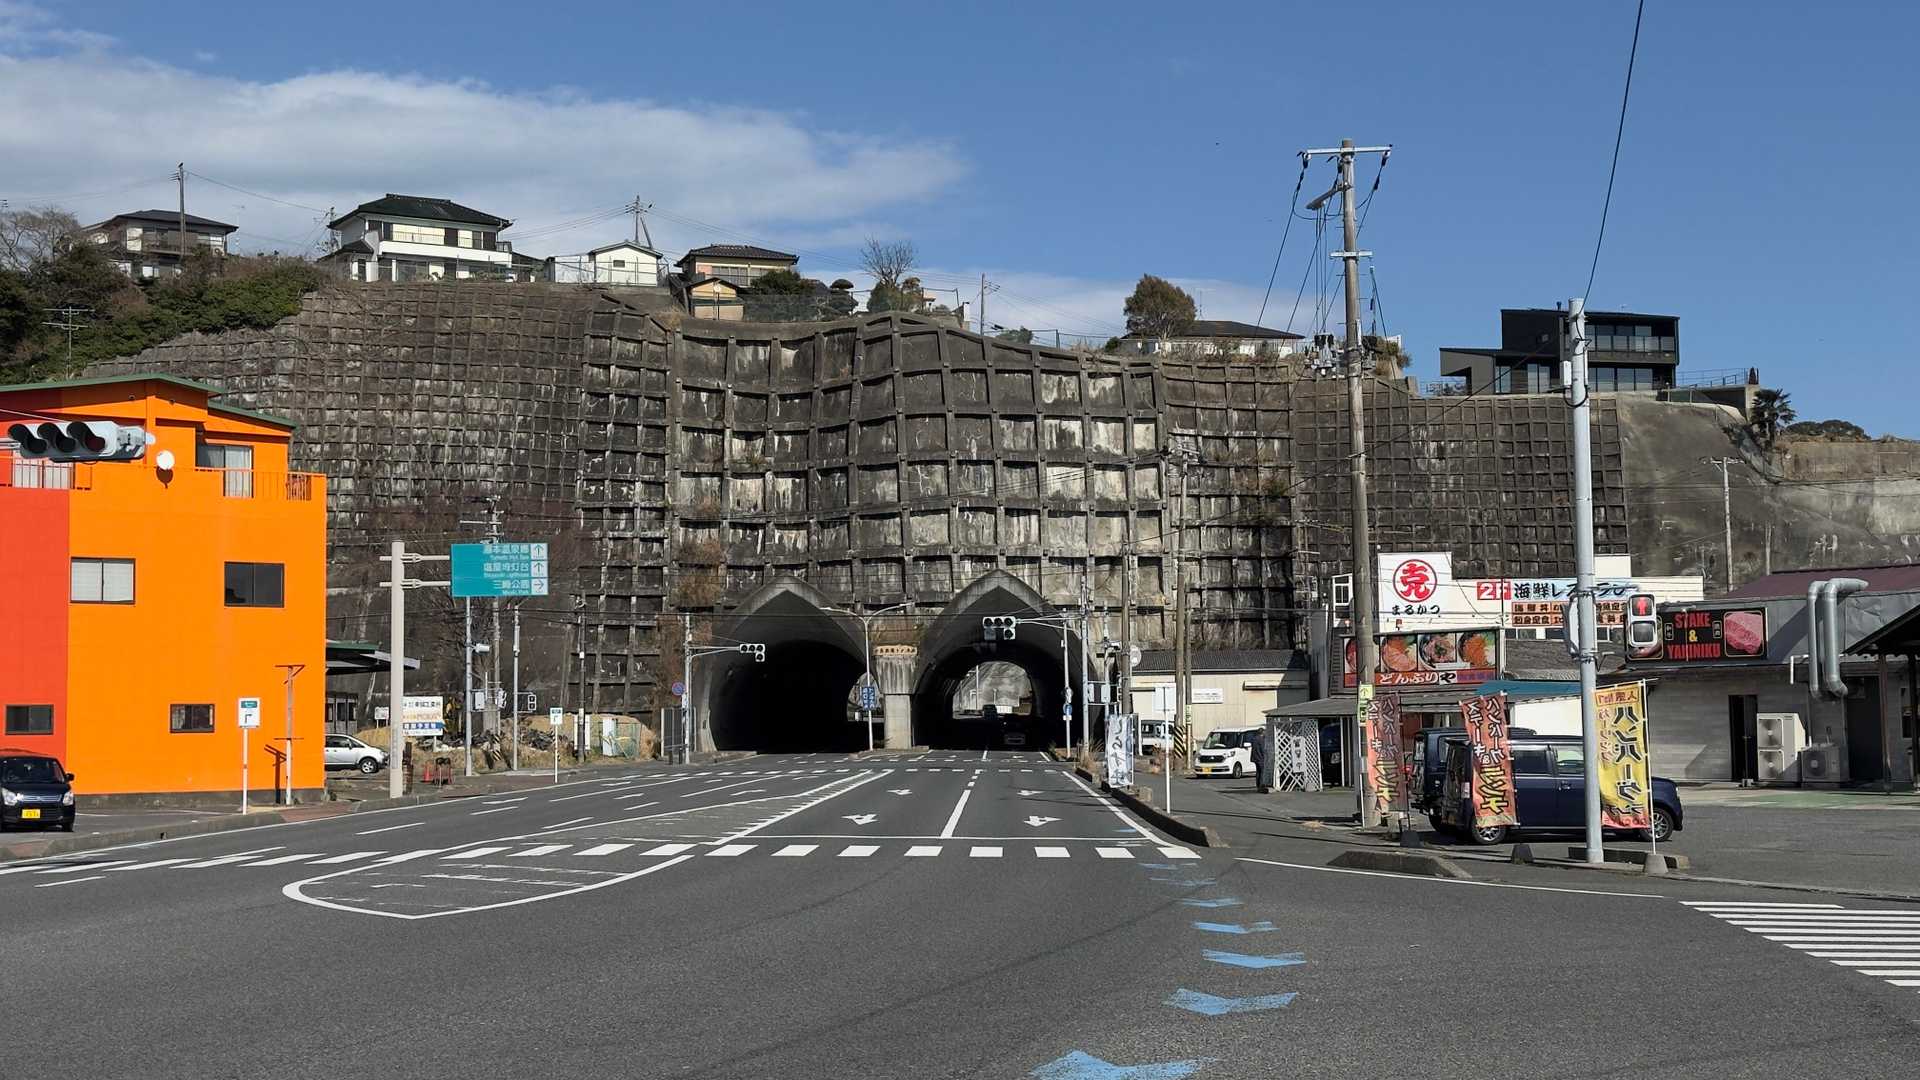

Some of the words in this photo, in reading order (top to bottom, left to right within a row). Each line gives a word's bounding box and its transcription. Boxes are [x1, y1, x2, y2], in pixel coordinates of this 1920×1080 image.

[1479, 582, 1508, 599] 2F
[1514, 582, 1638, 599] 海鮮レスラン
[1391, 604, 1441, 616] まるかつ
[1675, 612, 1711, 628] STAKE
[1688, 629, 1698, 642] &
